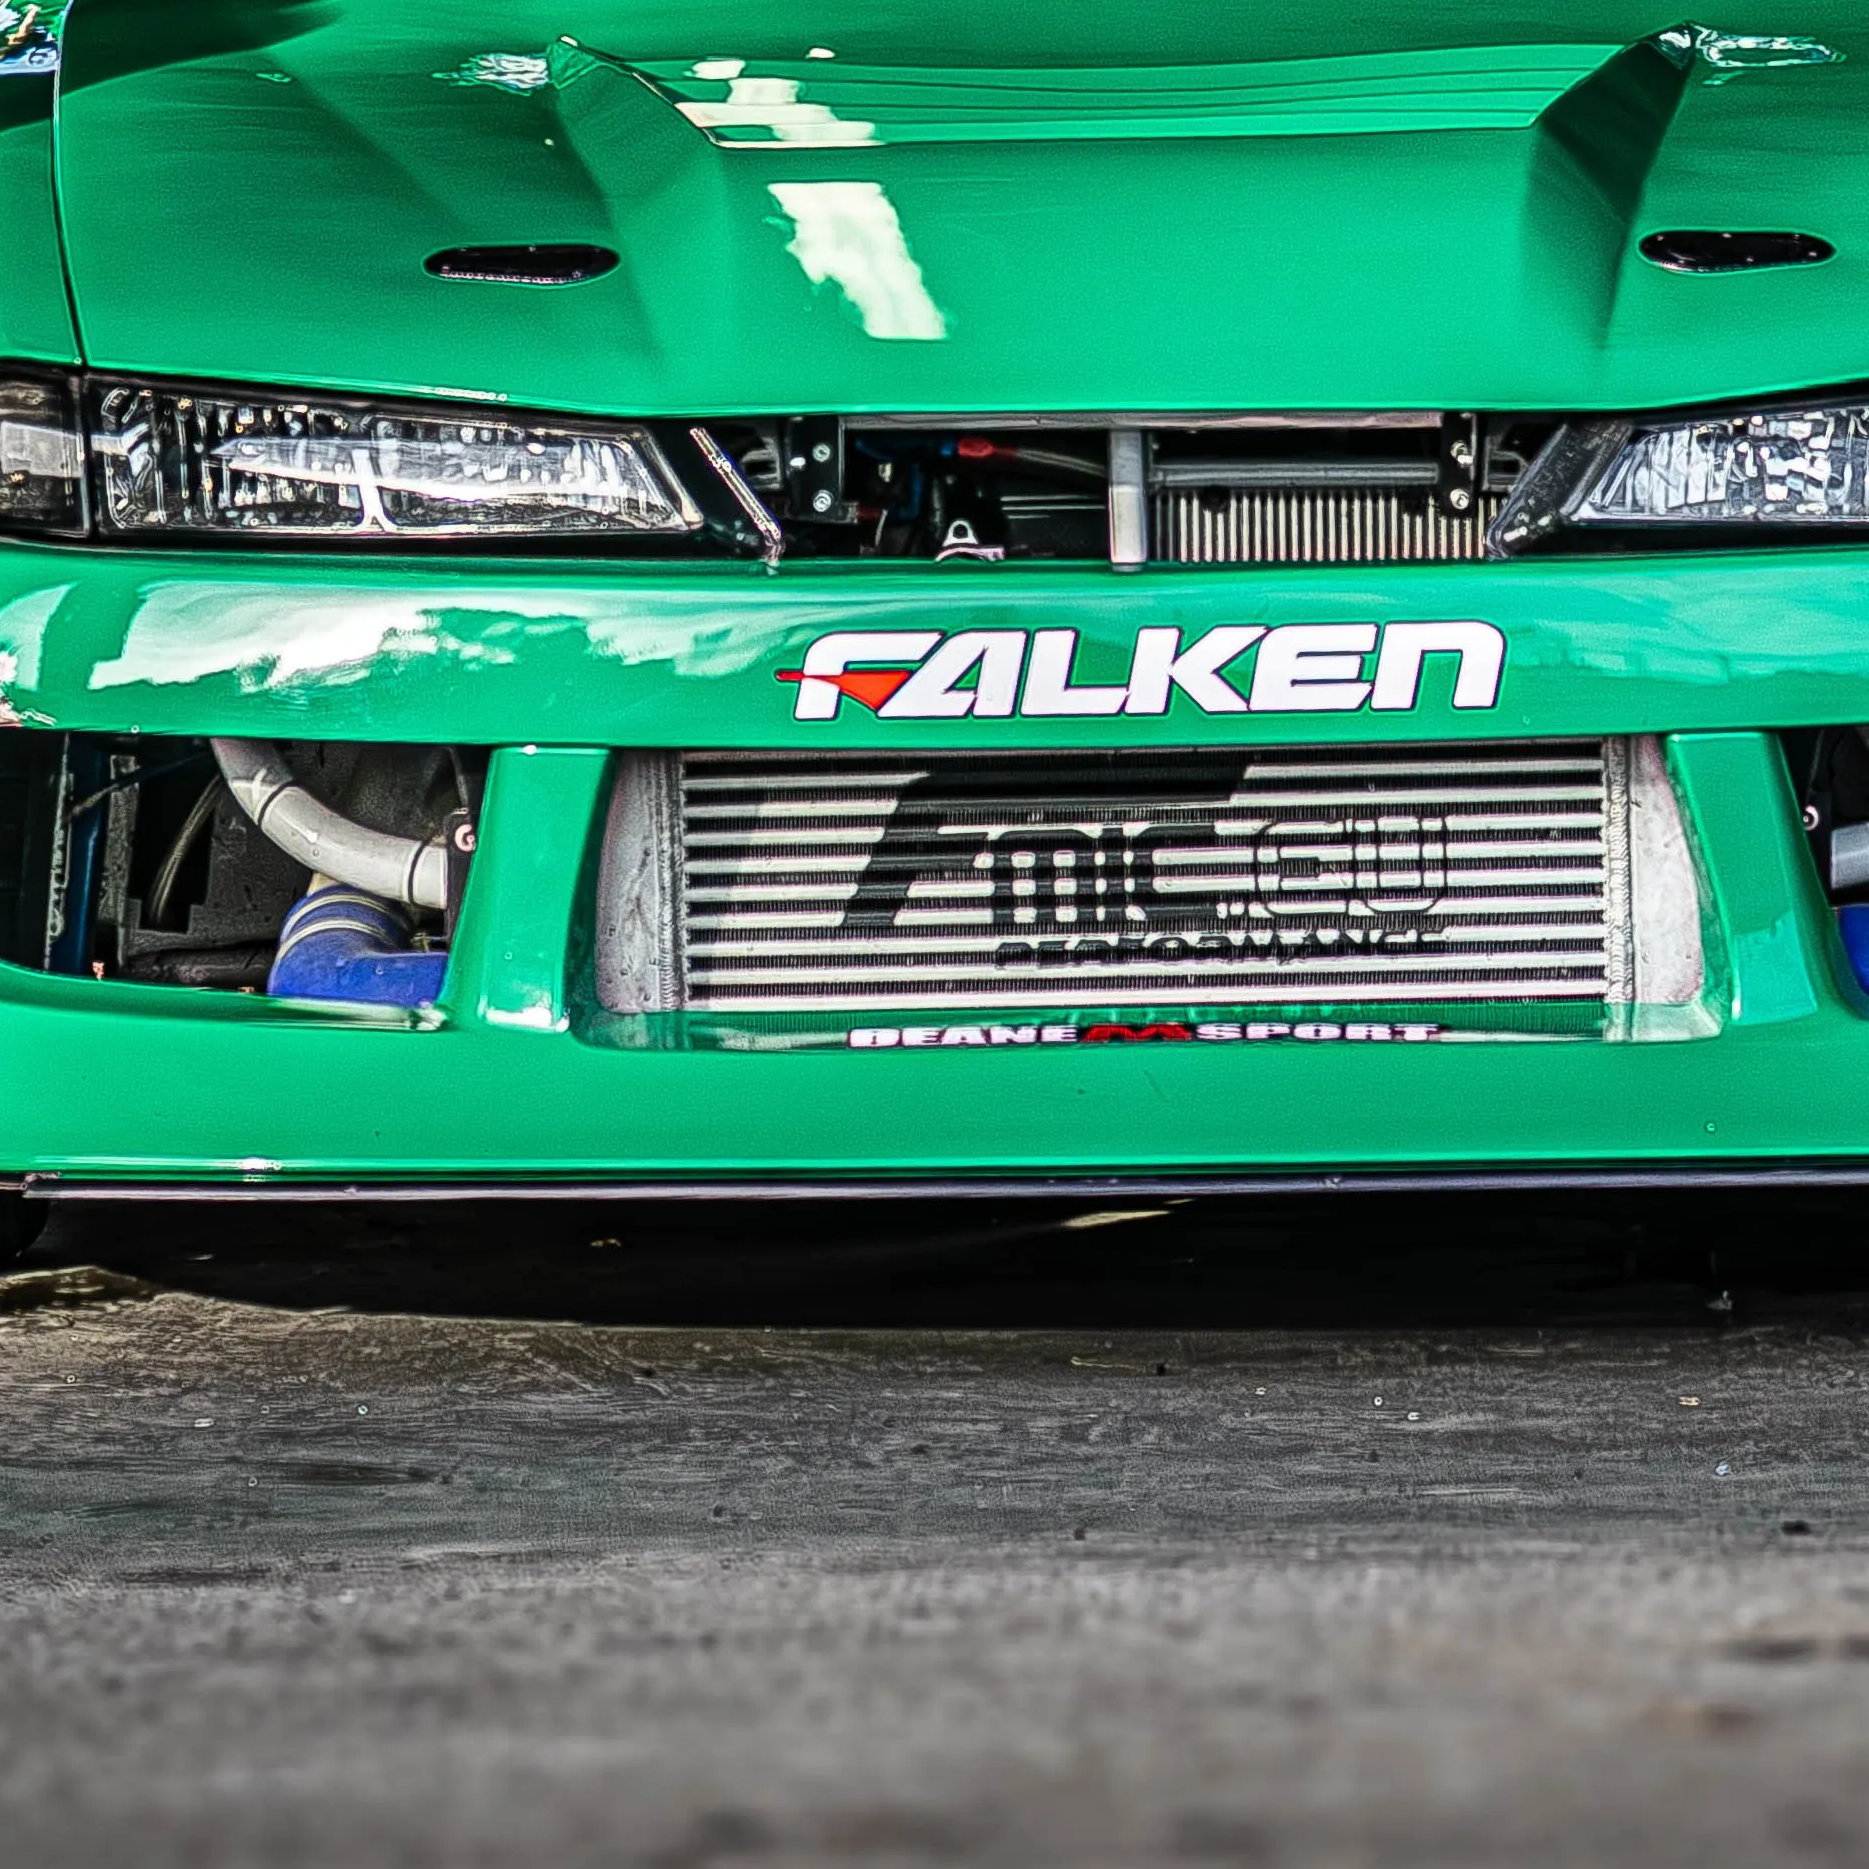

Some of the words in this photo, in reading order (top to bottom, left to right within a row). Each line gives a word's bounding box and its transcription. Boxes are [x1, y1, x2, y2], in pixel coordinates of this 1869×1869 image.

[780, 620, 1504, 720] FALKEN
[847, 1026, 1079, 1048] DEANE
[1196, 1023, 1444, 1042] SPORT
